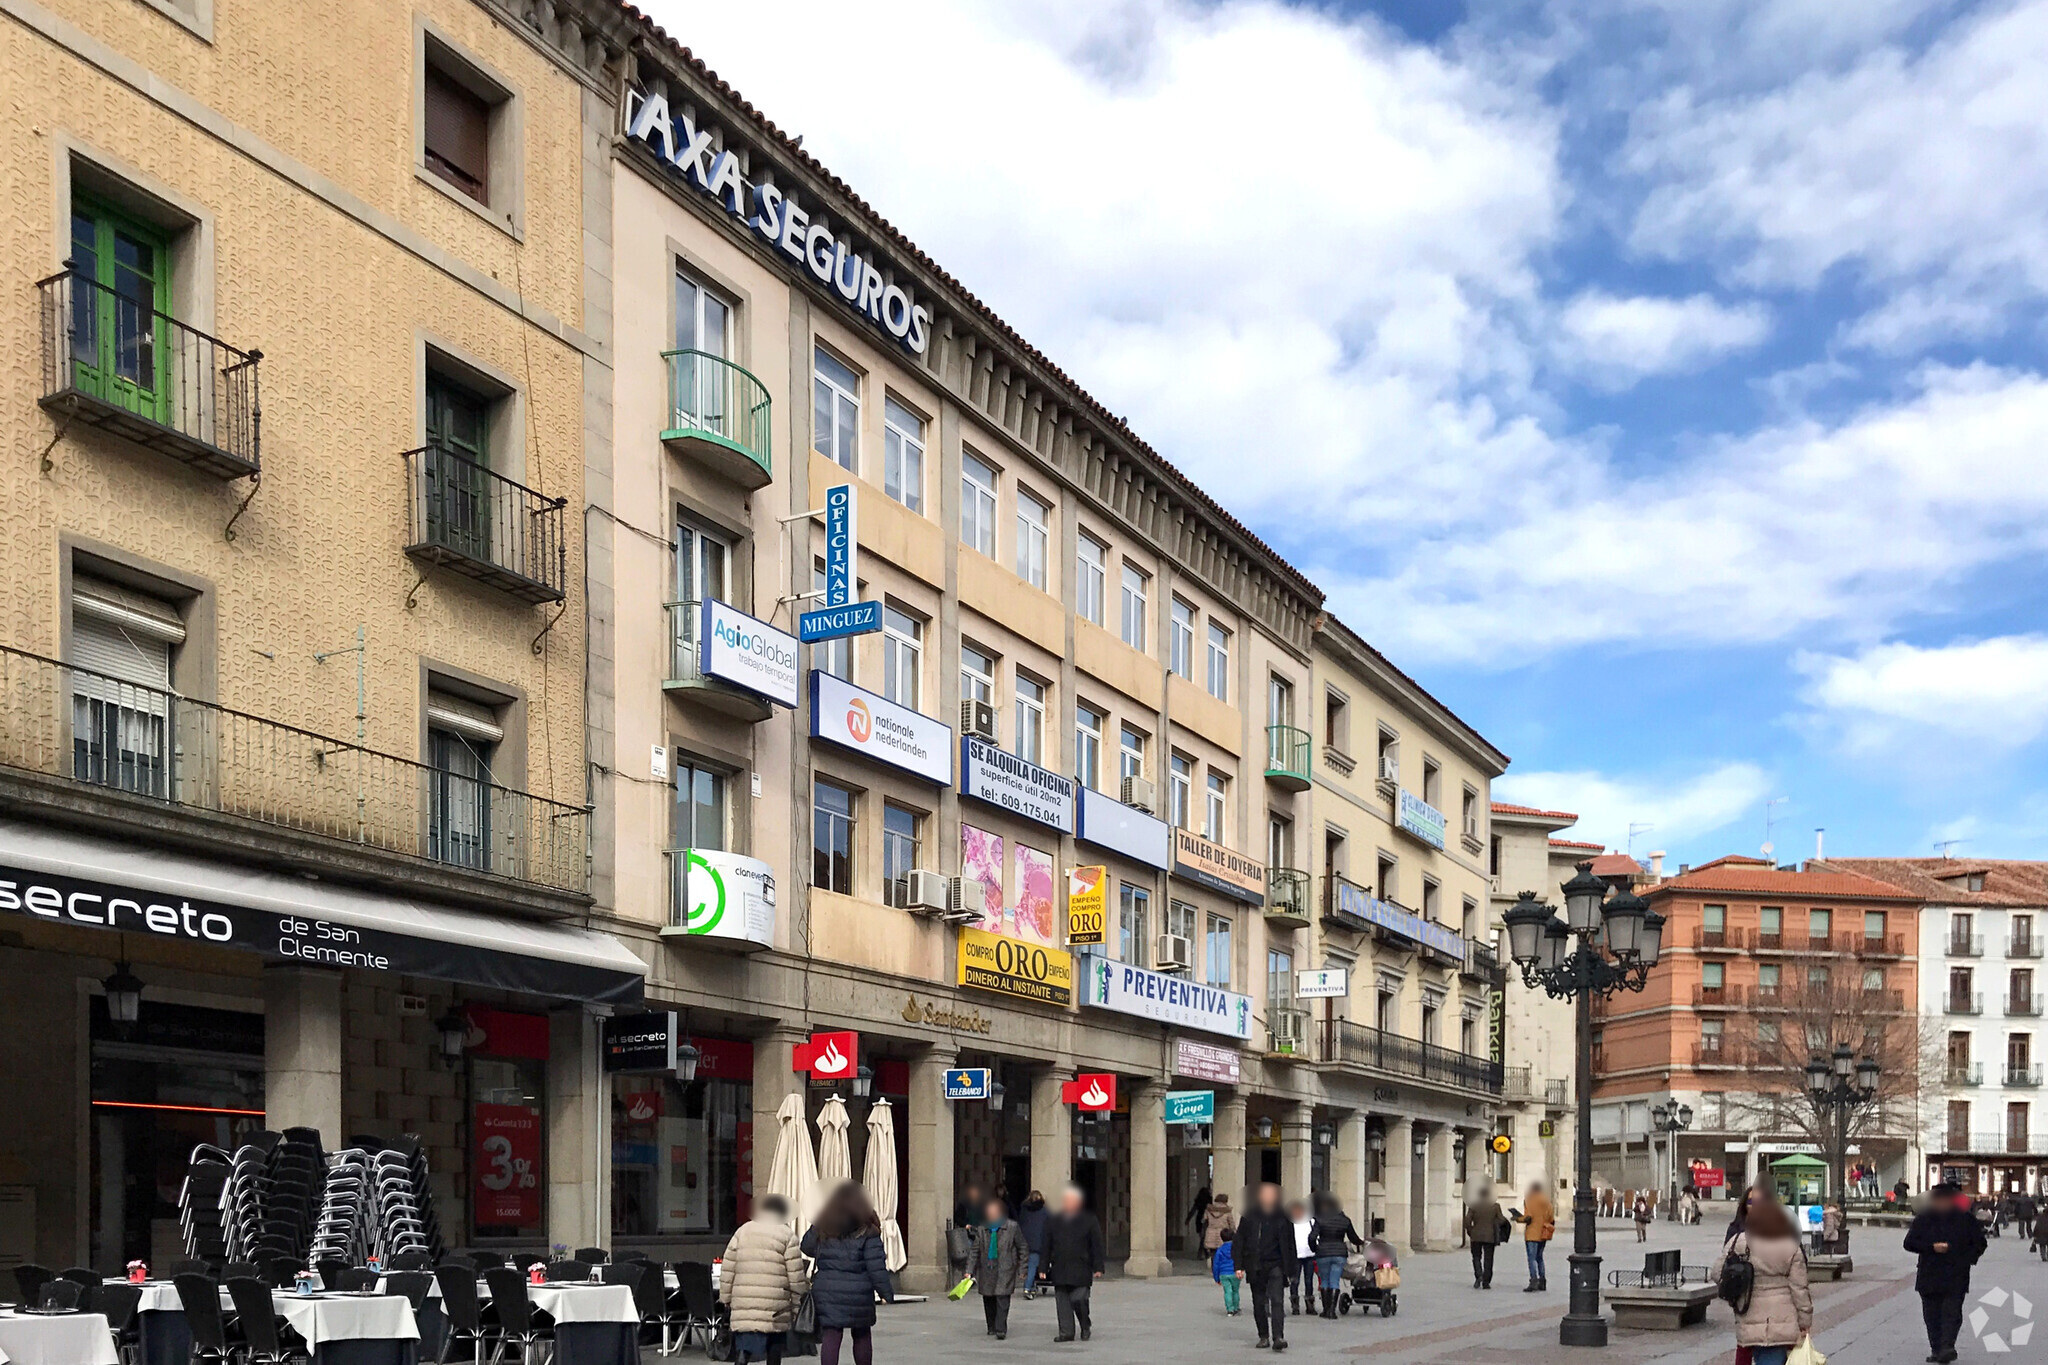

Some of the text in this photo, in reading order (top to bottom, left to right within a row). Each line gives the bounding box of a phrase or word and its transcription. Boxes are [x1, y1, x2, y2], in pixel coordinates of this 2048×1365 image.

[634, 92, 928, 354] AXA SEGUROS
[830, 493, 847, 604] OFICINAS
[804, 607, 874, 634] MINGUEZ
[714, 618, 796, 670] AgioGlobal
[738, 652, 796, 685] trabajo temporal
[875, 715, 915, 740] nationale
[875, 731, 928, 760] nederlanden
[970, 741, 1071, 798] SE ALQUILA OFICINA
[980, 767, 1062, 806] superficie útil 20m2
[981, 785, 1061, 826] tel: 609.175.041
[1179, 833, 1262, 882] TALLER DE JOYERIA
[1070, 912, 1102, 932] ORO
[1071, 904, 1101, 912] COMPRO
[279, 916, 360, 944] de San
[279, 937, 389, 970] Clemente
[966, 940, 1070, 981] COMPRO ORO EMPEÑO
[966, 969, 999, 987] DINERO
[1000, 977, 1012, 990] AL
[1012, 980, 1051, 999] INSTANTE
[1123, 968, 1228, 1016] PREVENTIVA
[923, 1001, 993, 1034] Santander
[1145, 1004, 1207, 1026] SEGUROS
[1490, 990, 1502, 1064] Bankia
[620, 1032, 667, 1043] secreto
[948, 1087, 983, 1096] TELEBANCO
[1173, 1103, 1204, 1117] Goyo
